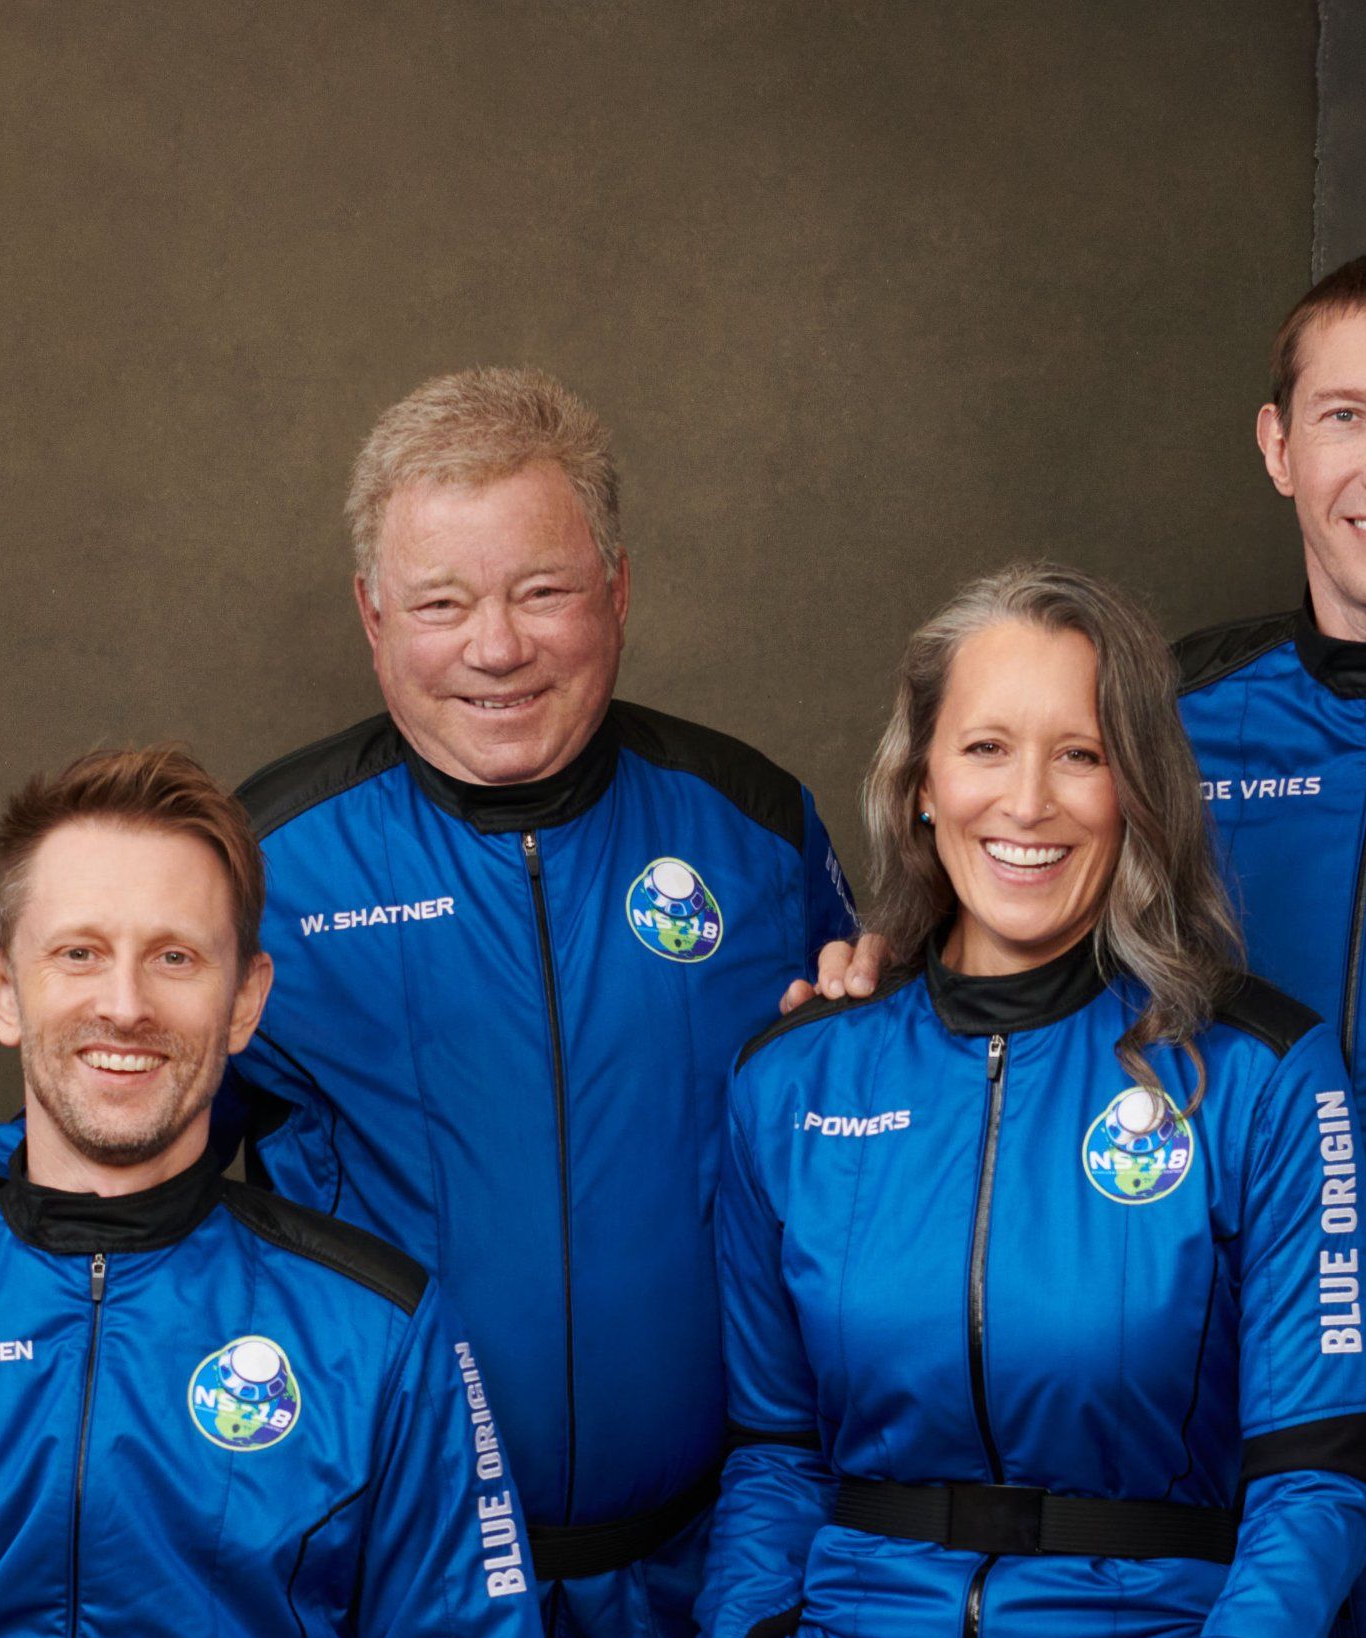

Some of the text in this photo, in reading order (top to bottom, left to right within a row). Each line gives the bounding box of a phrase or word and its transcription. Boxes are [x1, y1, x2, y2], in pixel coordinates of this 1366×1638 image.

[1240, 776, 1322, 800] VRIES
[300, 896, 455, 936] W. SHATNER
[632, 908, 719, 940] NS-18
[803, 1109, 911, 1138] POWERS
[1089, 1148, 1188, 1170] NS-18
[1315, 1090, 1363, 1354] BLUE ORIGIN
[194, 1384, 293, 1429] NS-18
[454, 1341, 527, 1598] BLUE ORIGIN
